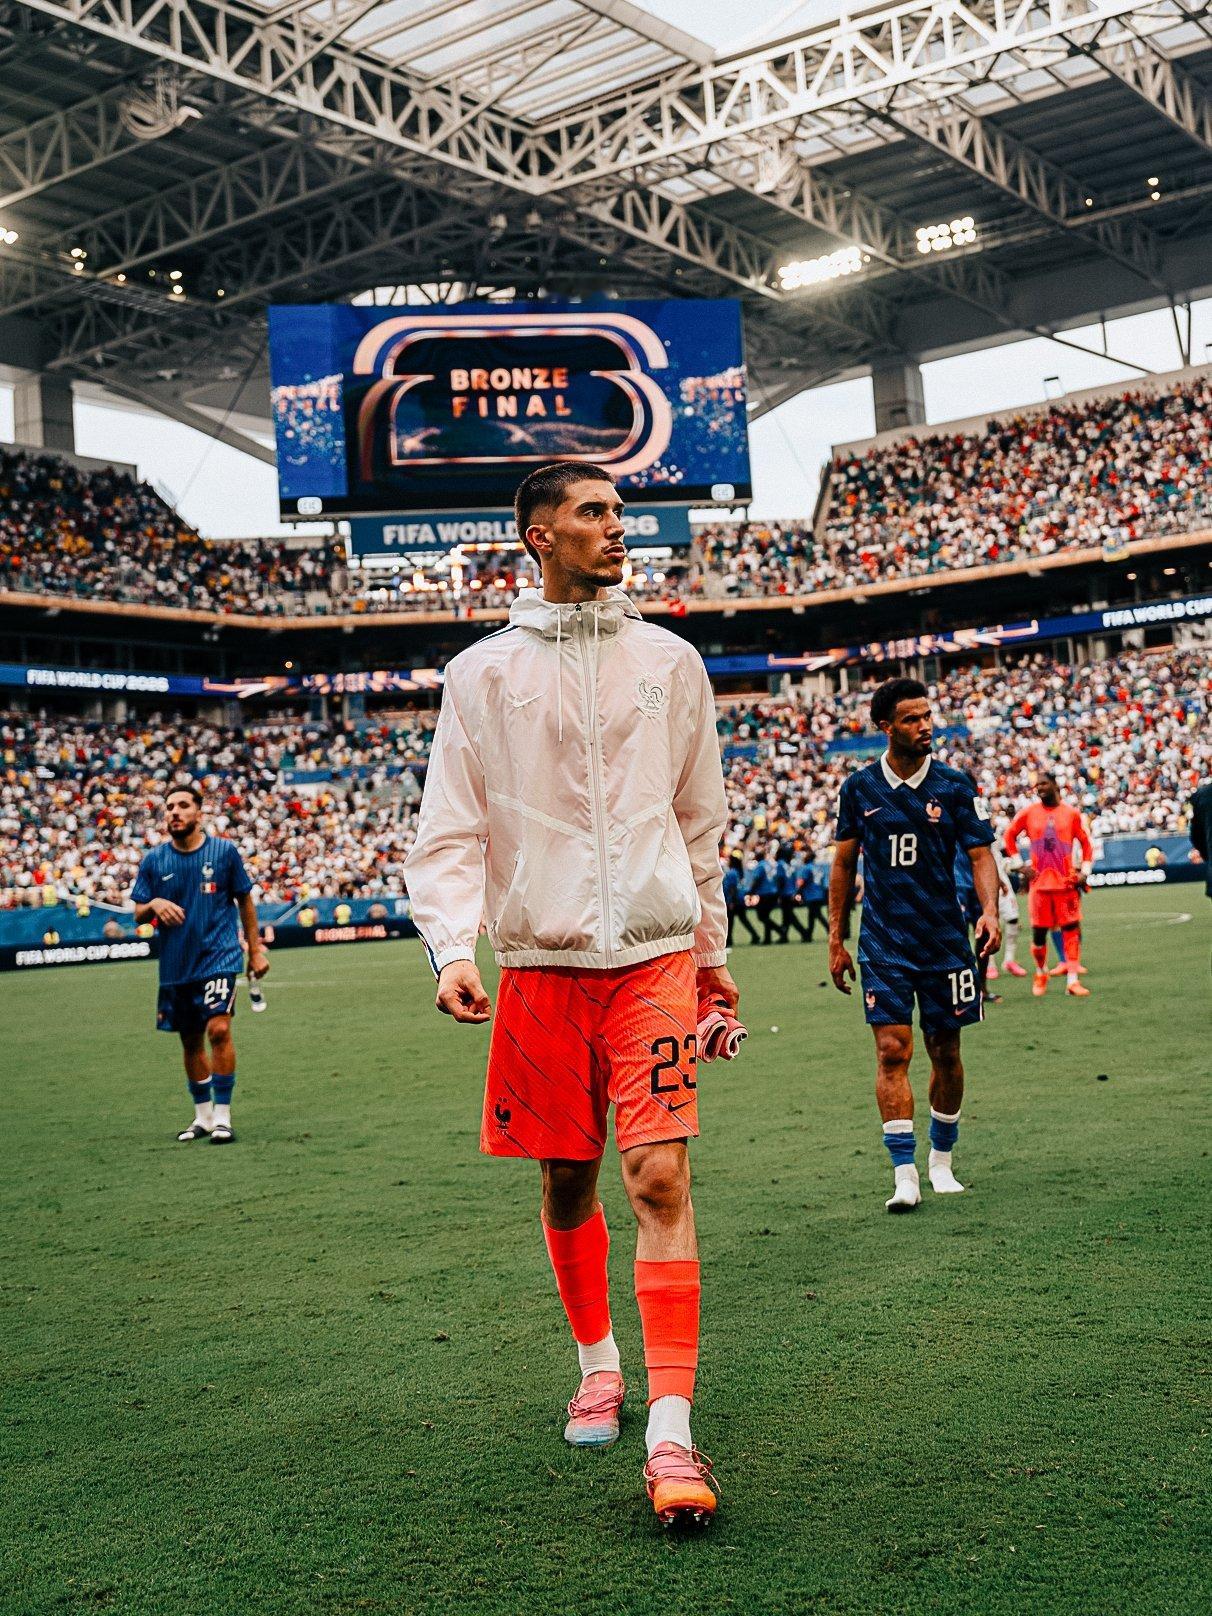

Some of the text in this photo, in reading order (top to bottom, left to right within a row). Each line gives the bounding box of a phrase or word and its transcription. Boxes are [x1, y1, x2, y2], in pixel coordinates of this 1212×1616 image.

[450, 368, 569, 391] BRONZE
[452, 395, 571, 418] FINAL
[383, 514, 660, 545] FIFA WORLD 26
[1102, 610, 1135, 627] FIFA
[1133, 603, 1185, 623] WORLD
[27, 669, 57, 686] FIFA
[56, 671, 101, 688] WORLD
[101, 674, 127, 689] CUP
[888, 834, 917, 866] 18
[16, 949, 44, 965] FIFA
[43, 946, 86, 963] WORLD
[86, 945, 109, 960] CUP
[204, 978, 229, 1004] 24
[948, 969, 975, 1005] 18
[650, 1033, 697, 1095] 23
